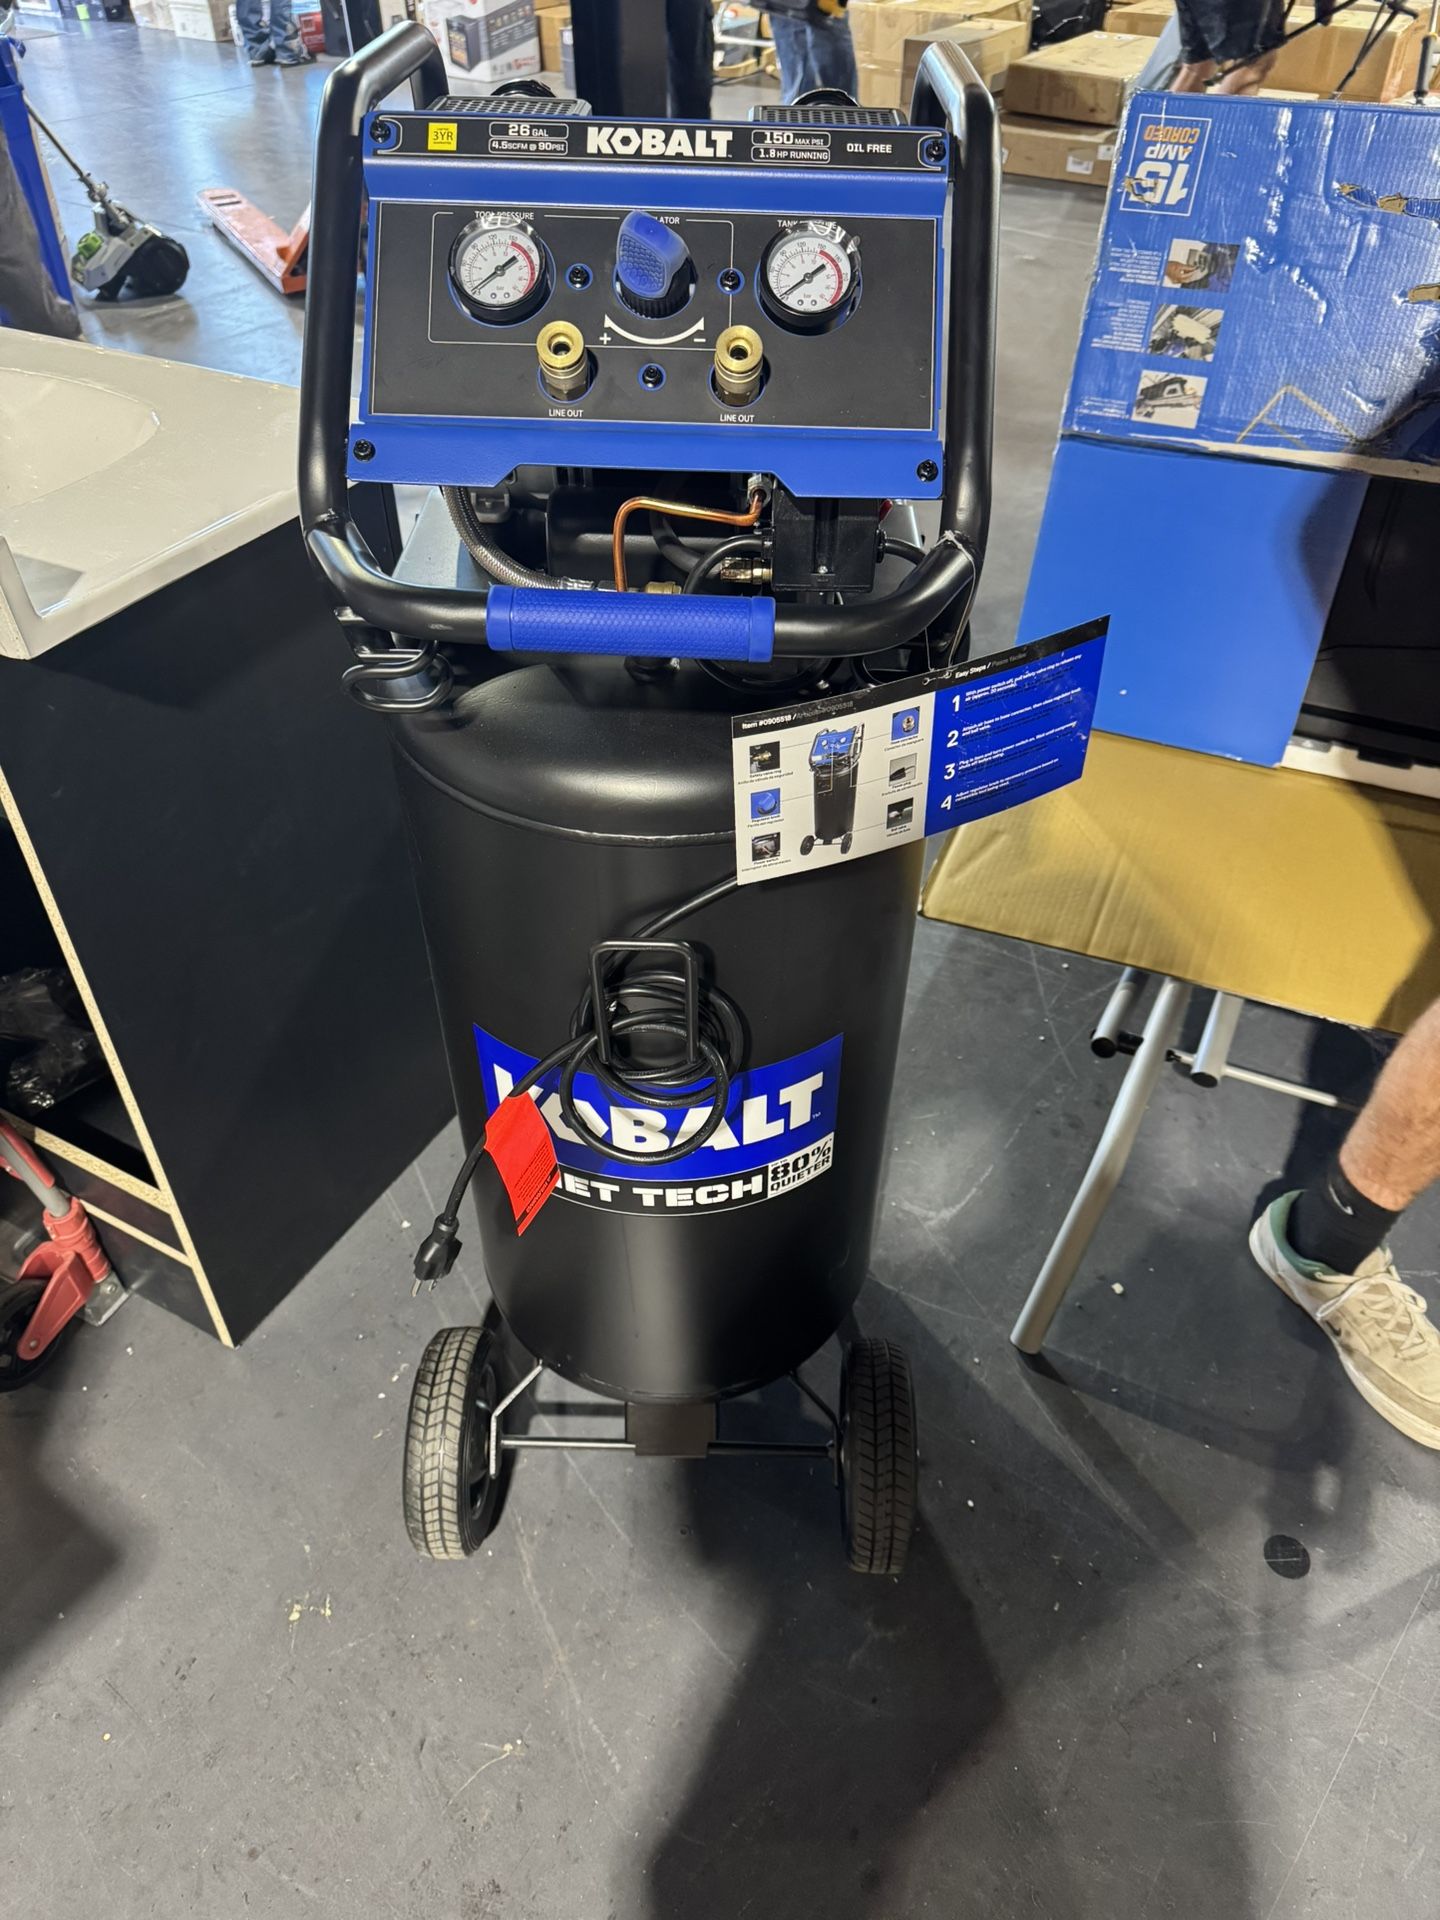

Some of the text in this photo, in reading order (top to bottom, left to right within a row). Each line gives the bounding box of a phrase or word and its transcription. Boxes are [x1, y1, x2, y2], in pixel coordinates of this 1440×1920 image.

[508, 124, 549, 137] 26 GAL
[764, 132, 793, 144] 150
[1143, 124, 1200, 145] CORDED
[586, 126, 733, 158] KOBALT
[846, 143, 892, 154] OIL FREE
[759, 148, 828, 160] 1.8 HP RUNNING
[1144, 145, 1193, 162] AMP
[1127, 161, 1190, 206] 15
[548, 408, 584, 418] LINE OUT
[719, 413, 755, 423] LINE OUT
[955, 670, 969, 679] Easy
[969, 664, 987, 675] Steps
[952, 694, 960, 713] 1
[742, 722, 758, 730] Item
[946, 730, 959, 748] 2
[944, 763, 956, 780] 3
[941, 795, 952, 810] 4
[770, 1140, 832, 1181] 80%
[770, 1155, 831, 1192] QUIETER
[555, 1172, 620, 1203] ET
[632, 1174, 763, 1207] TECH
